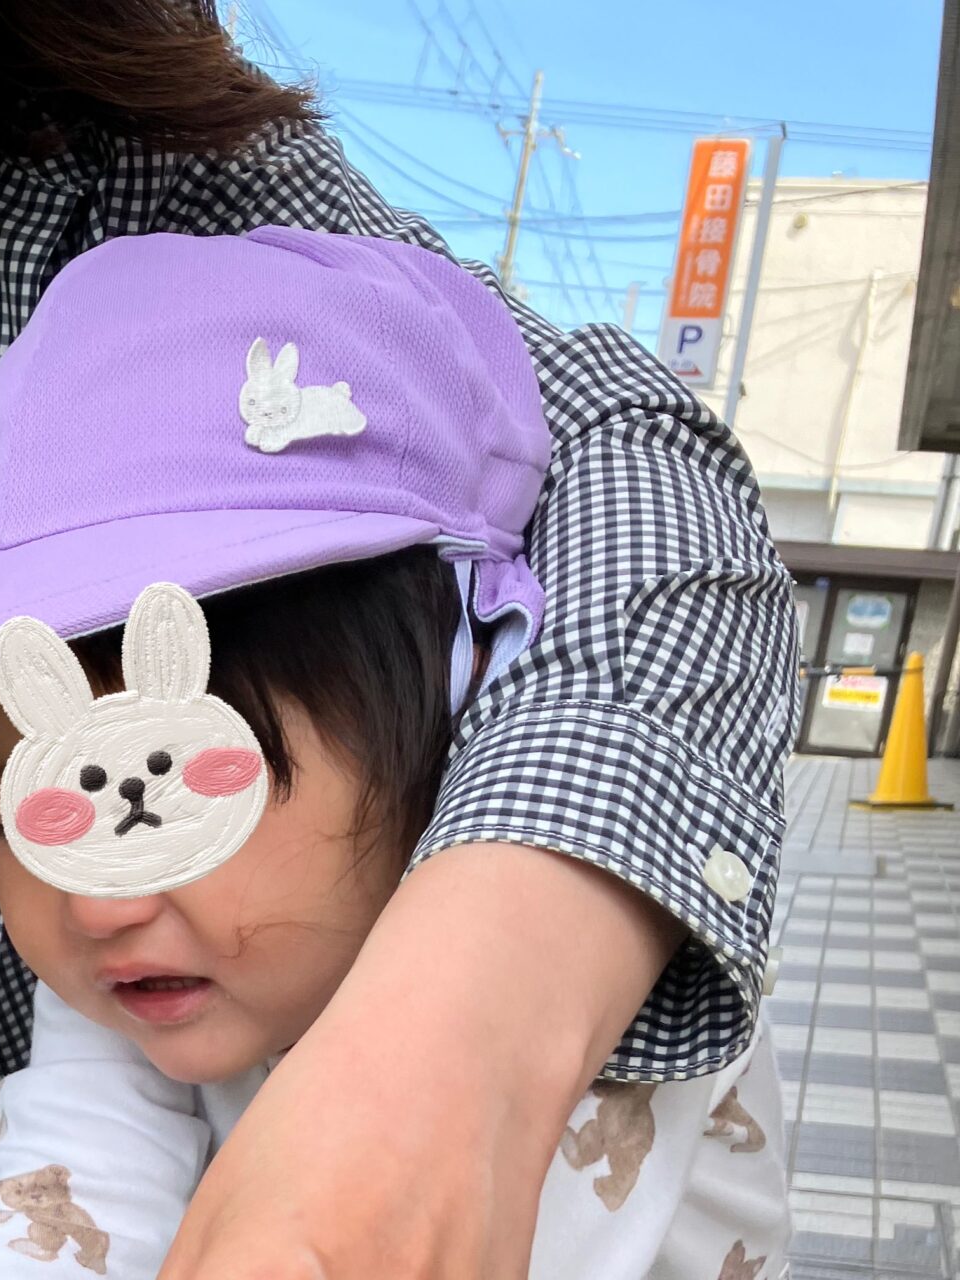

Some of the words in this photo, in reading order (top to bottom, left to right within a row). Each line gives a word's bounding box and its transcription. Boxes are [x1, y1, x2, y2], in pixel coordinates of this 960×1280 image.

[689, 151, 739, 309] 藤田接骨院
[677, 325, 703, 353] P
